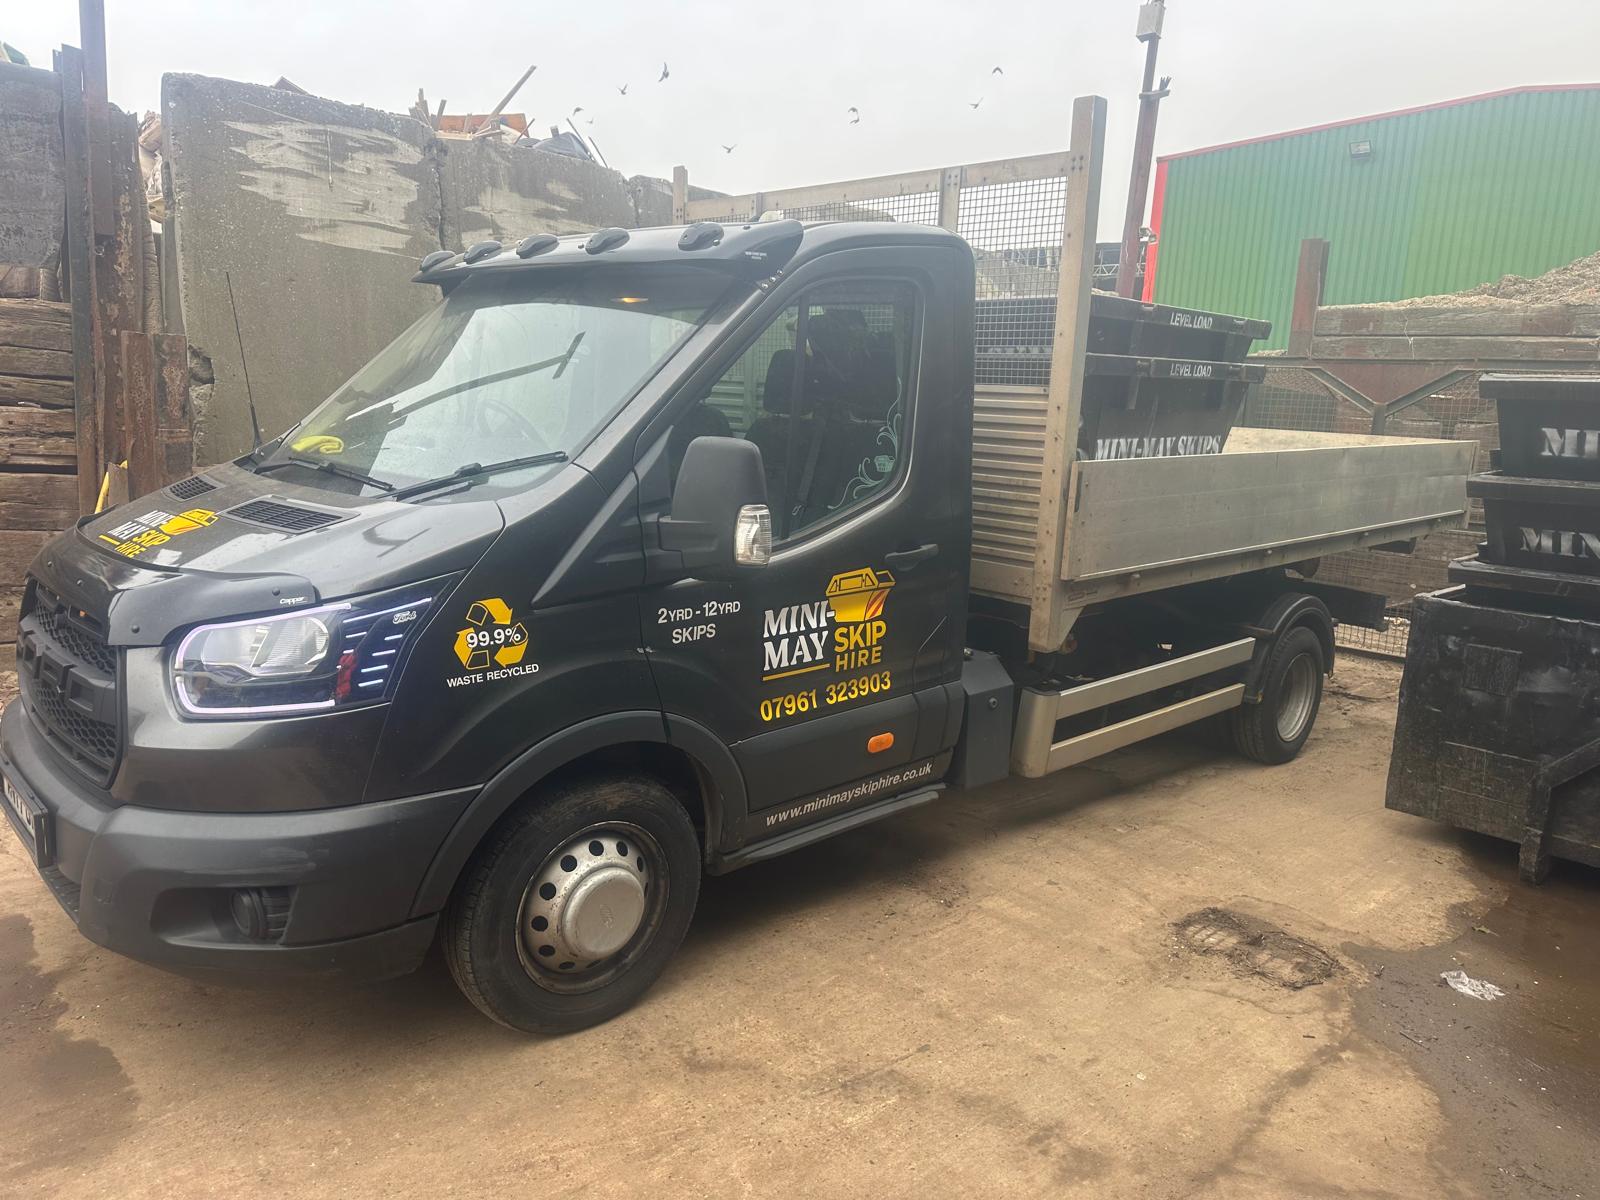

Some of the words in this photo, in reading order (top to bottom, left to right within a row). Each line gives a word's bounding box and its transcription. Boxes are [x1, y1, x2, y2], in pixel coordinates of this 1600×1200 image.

[1169, 311, 1193, 328] LEVEL
[1193, 314, 1213, 329] LOAD
[1169, 362, 1192, 377] LEVEL
[1193, 364, 1212, 377] LOAD
[1095, 438, 1176, 460] MINI-MAY
[1177, 435, 1221, 455] SKIPS
[107, 521, 150, 540] MAY
[132, 529, 171, 548] SKIP
[114, 540, 147, 558] HIRE
[392, 610, 417, 625] Ford
[657, 607, 693, 624] 2YRD
[702, 600, 741, 617] 12YRD
[763, 600, 835, 638] MINI-
[466, 626, 521, 648] 99.9%
[672, 623, 716, 644] SKIPS
[833, 620, 887, 653] SKIP
[763, 630, 829, 671] MAY
[835, 645, 882, 672] HIRE
[446, 673, 484, 688] WASTE
[486, 663, 540, 681] RECYCLED
[760, 688, 817, 721] 07961
[825, 670, 891, 705] 323903
[766, 762, 933, 827] www.minimayskiphire.co.uk
